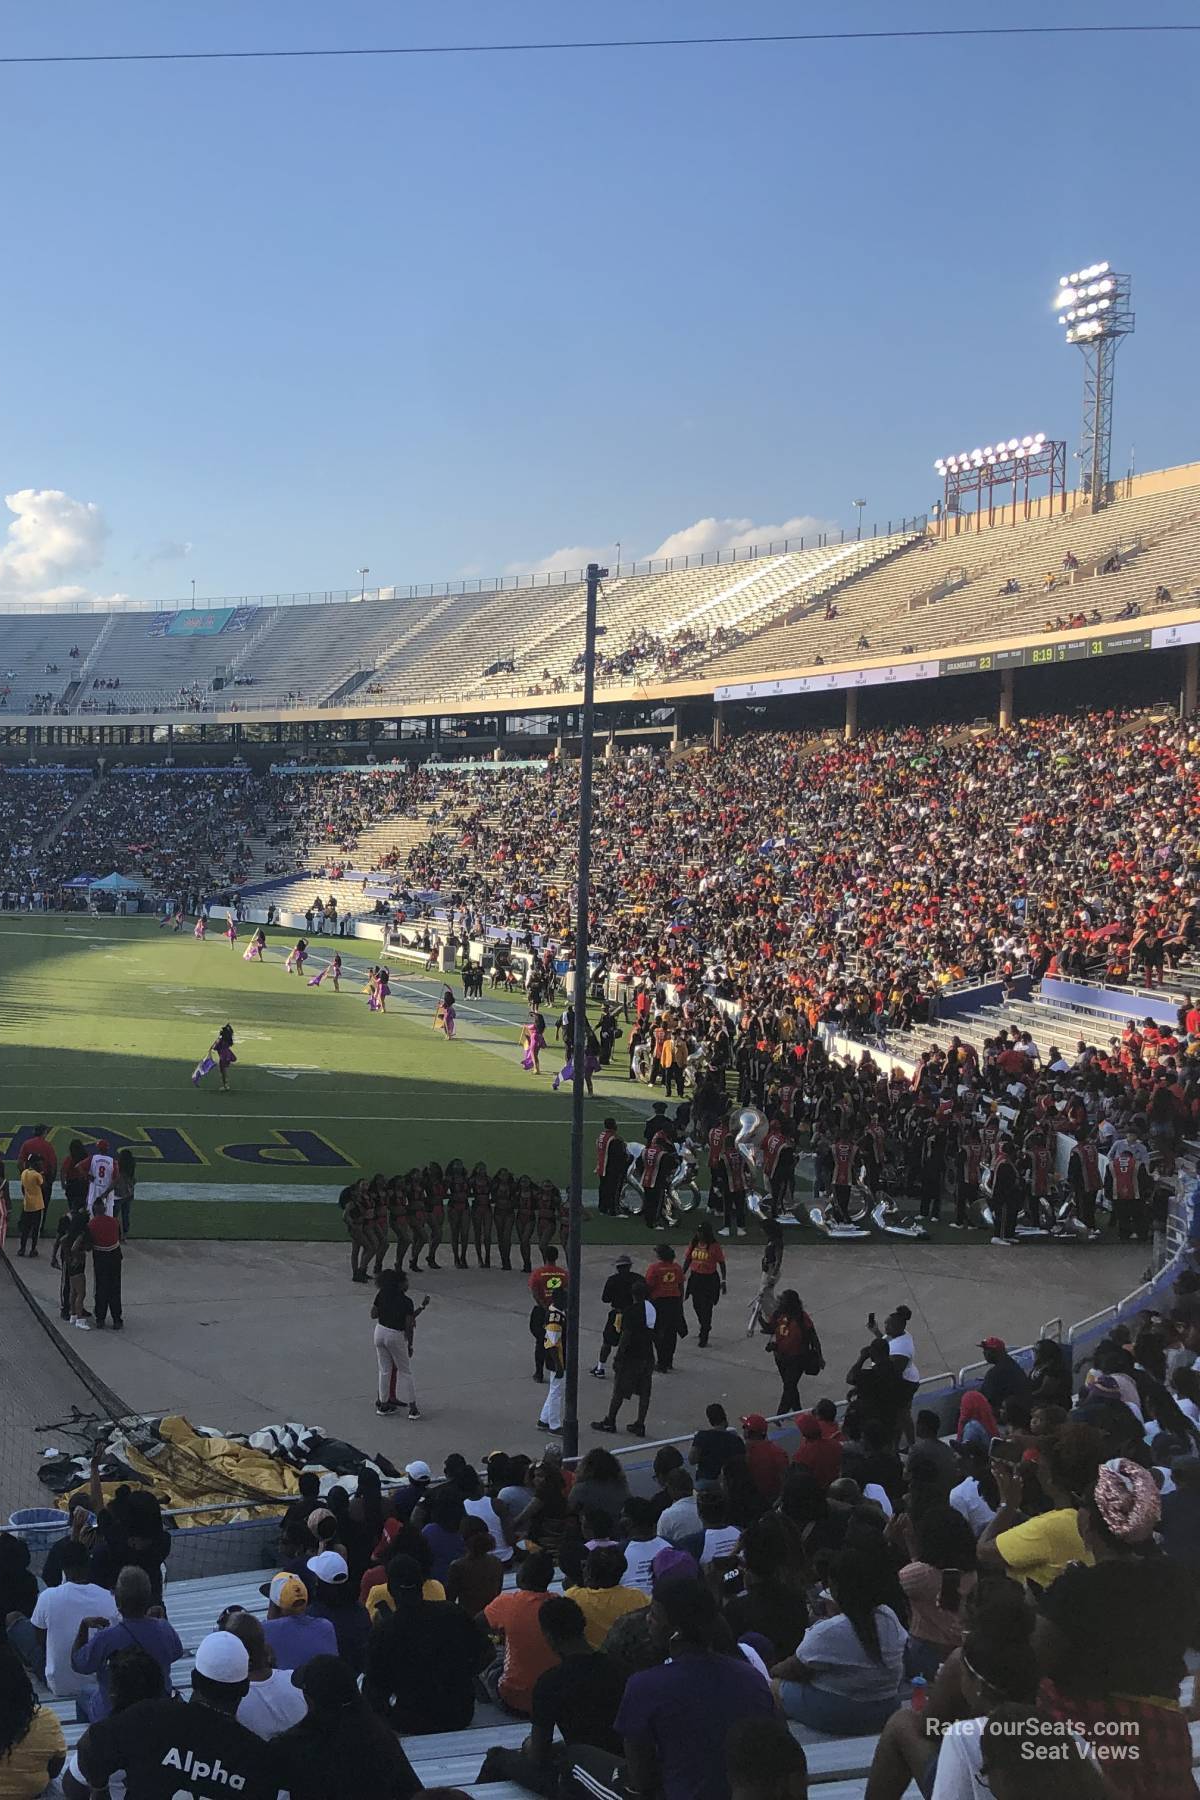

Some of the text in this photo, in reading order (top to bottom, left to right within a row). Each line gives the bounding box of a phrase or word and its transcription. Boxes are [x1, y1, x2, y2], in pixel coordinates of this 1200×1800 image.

[1091, 641, 1103, 654] 31
[1033, 648, 1052, 662] 8:19
[980, 657, 991, 669] 23
[98, 1166, 105, 1178] 8
[161, 1747, 246, 1791] Alpha
